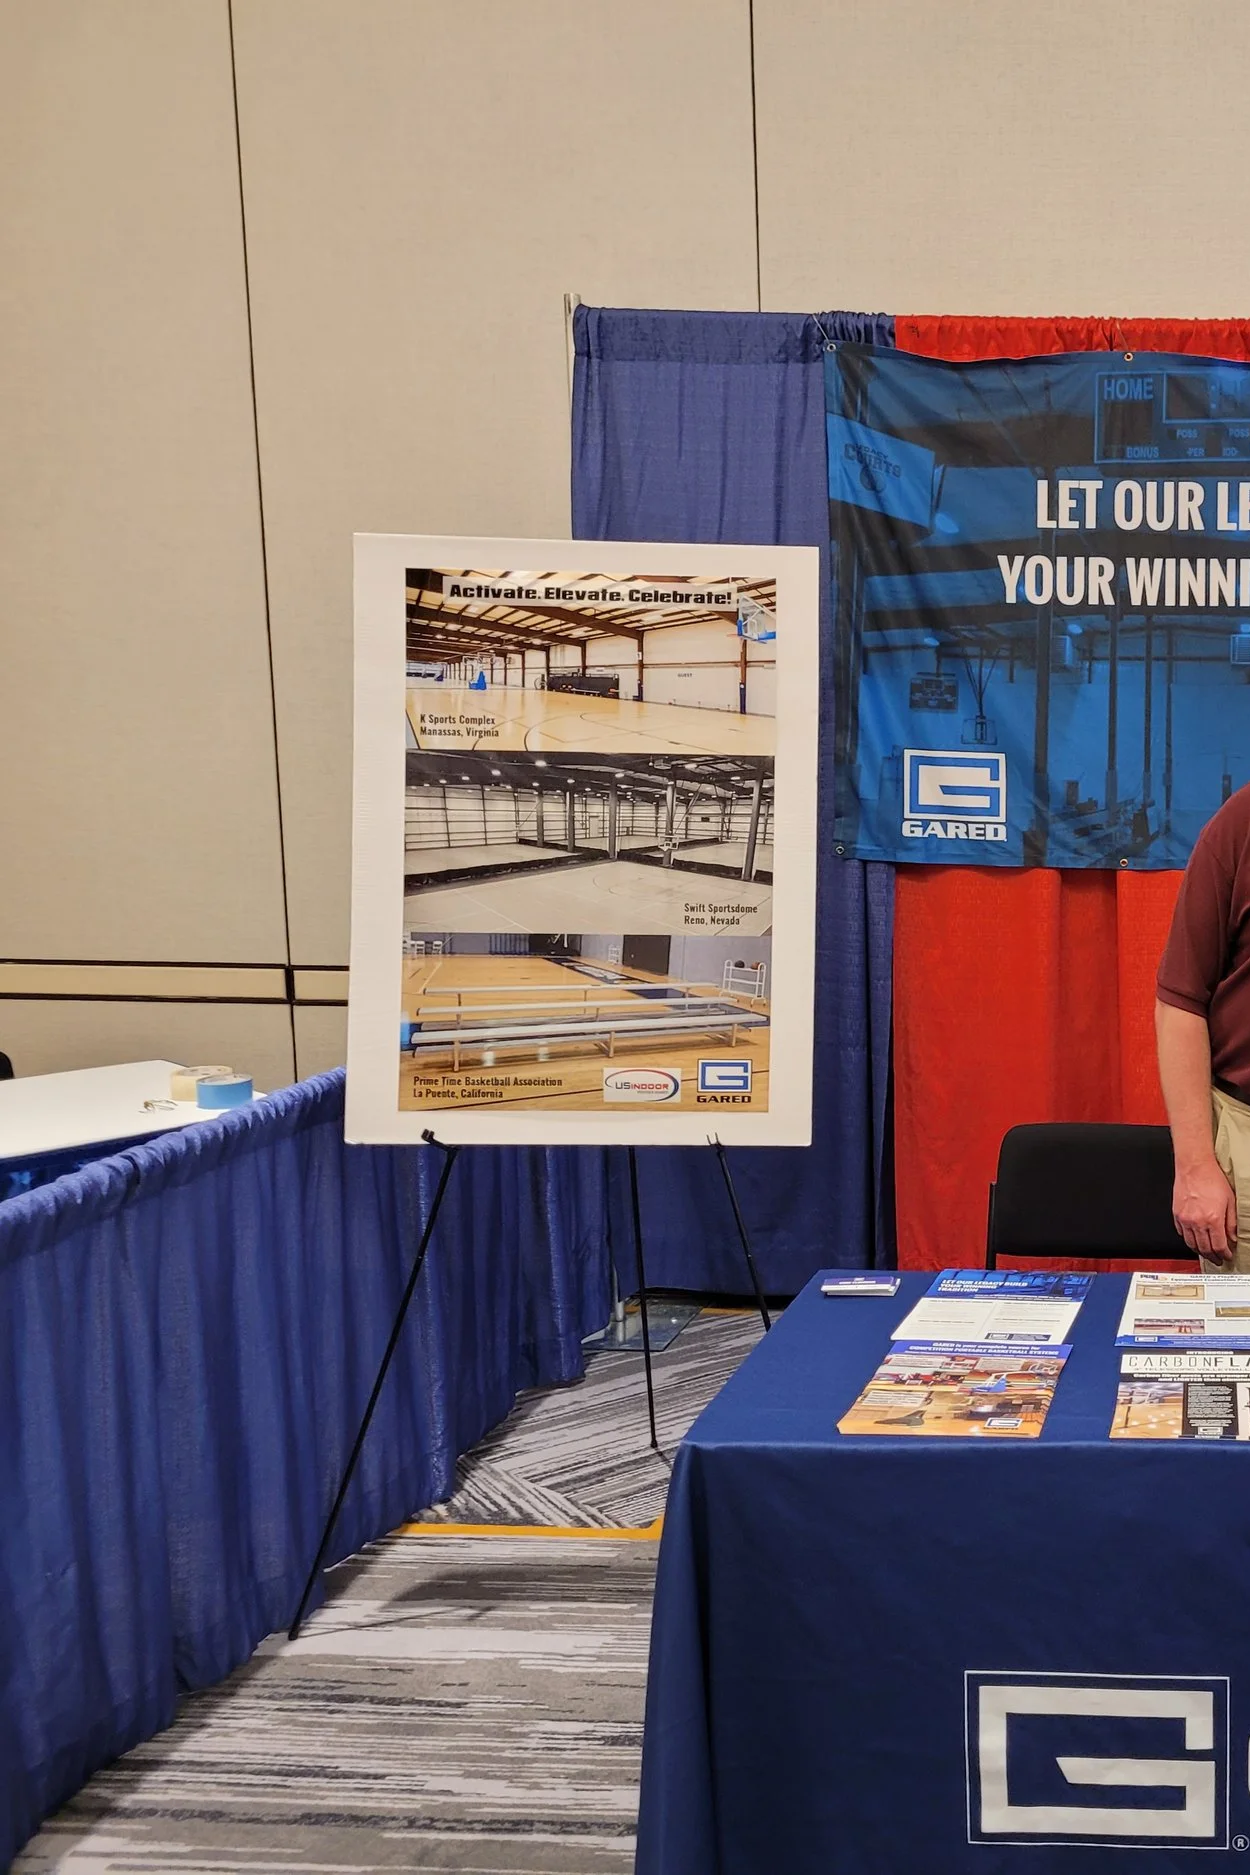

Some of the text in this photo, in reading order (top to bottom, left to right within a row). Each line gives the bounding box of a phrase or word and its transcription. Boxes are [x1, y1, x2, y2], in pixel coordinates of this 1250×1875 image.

[1103, 378, 1153, 400] HOME
[1126, 446, 1159, 459] BONUS
[1036, 479, 1103, 530] LET
[1113, 480, 1205, 532] OUR
[997, 555, 1115, 606] YOUR
[450, 584, 732, 604] Activate. Elevate. Celebrate!
[420, 714, 495, 726] K Sports Complex
[420, 726, 499, 739] Manassas, Virginia
[902, 821, 1007, 842] GARED
[684, 903, 758, 914] Swift Sportsdome
[684, 915, 740, 925] Reno, Nevada
[413, 1076, 563, 1087] Prime Time Basketball Association
[413, 1088, 504, 1100] La Puente, California
[696, 1095, 752, 1103] GARED
